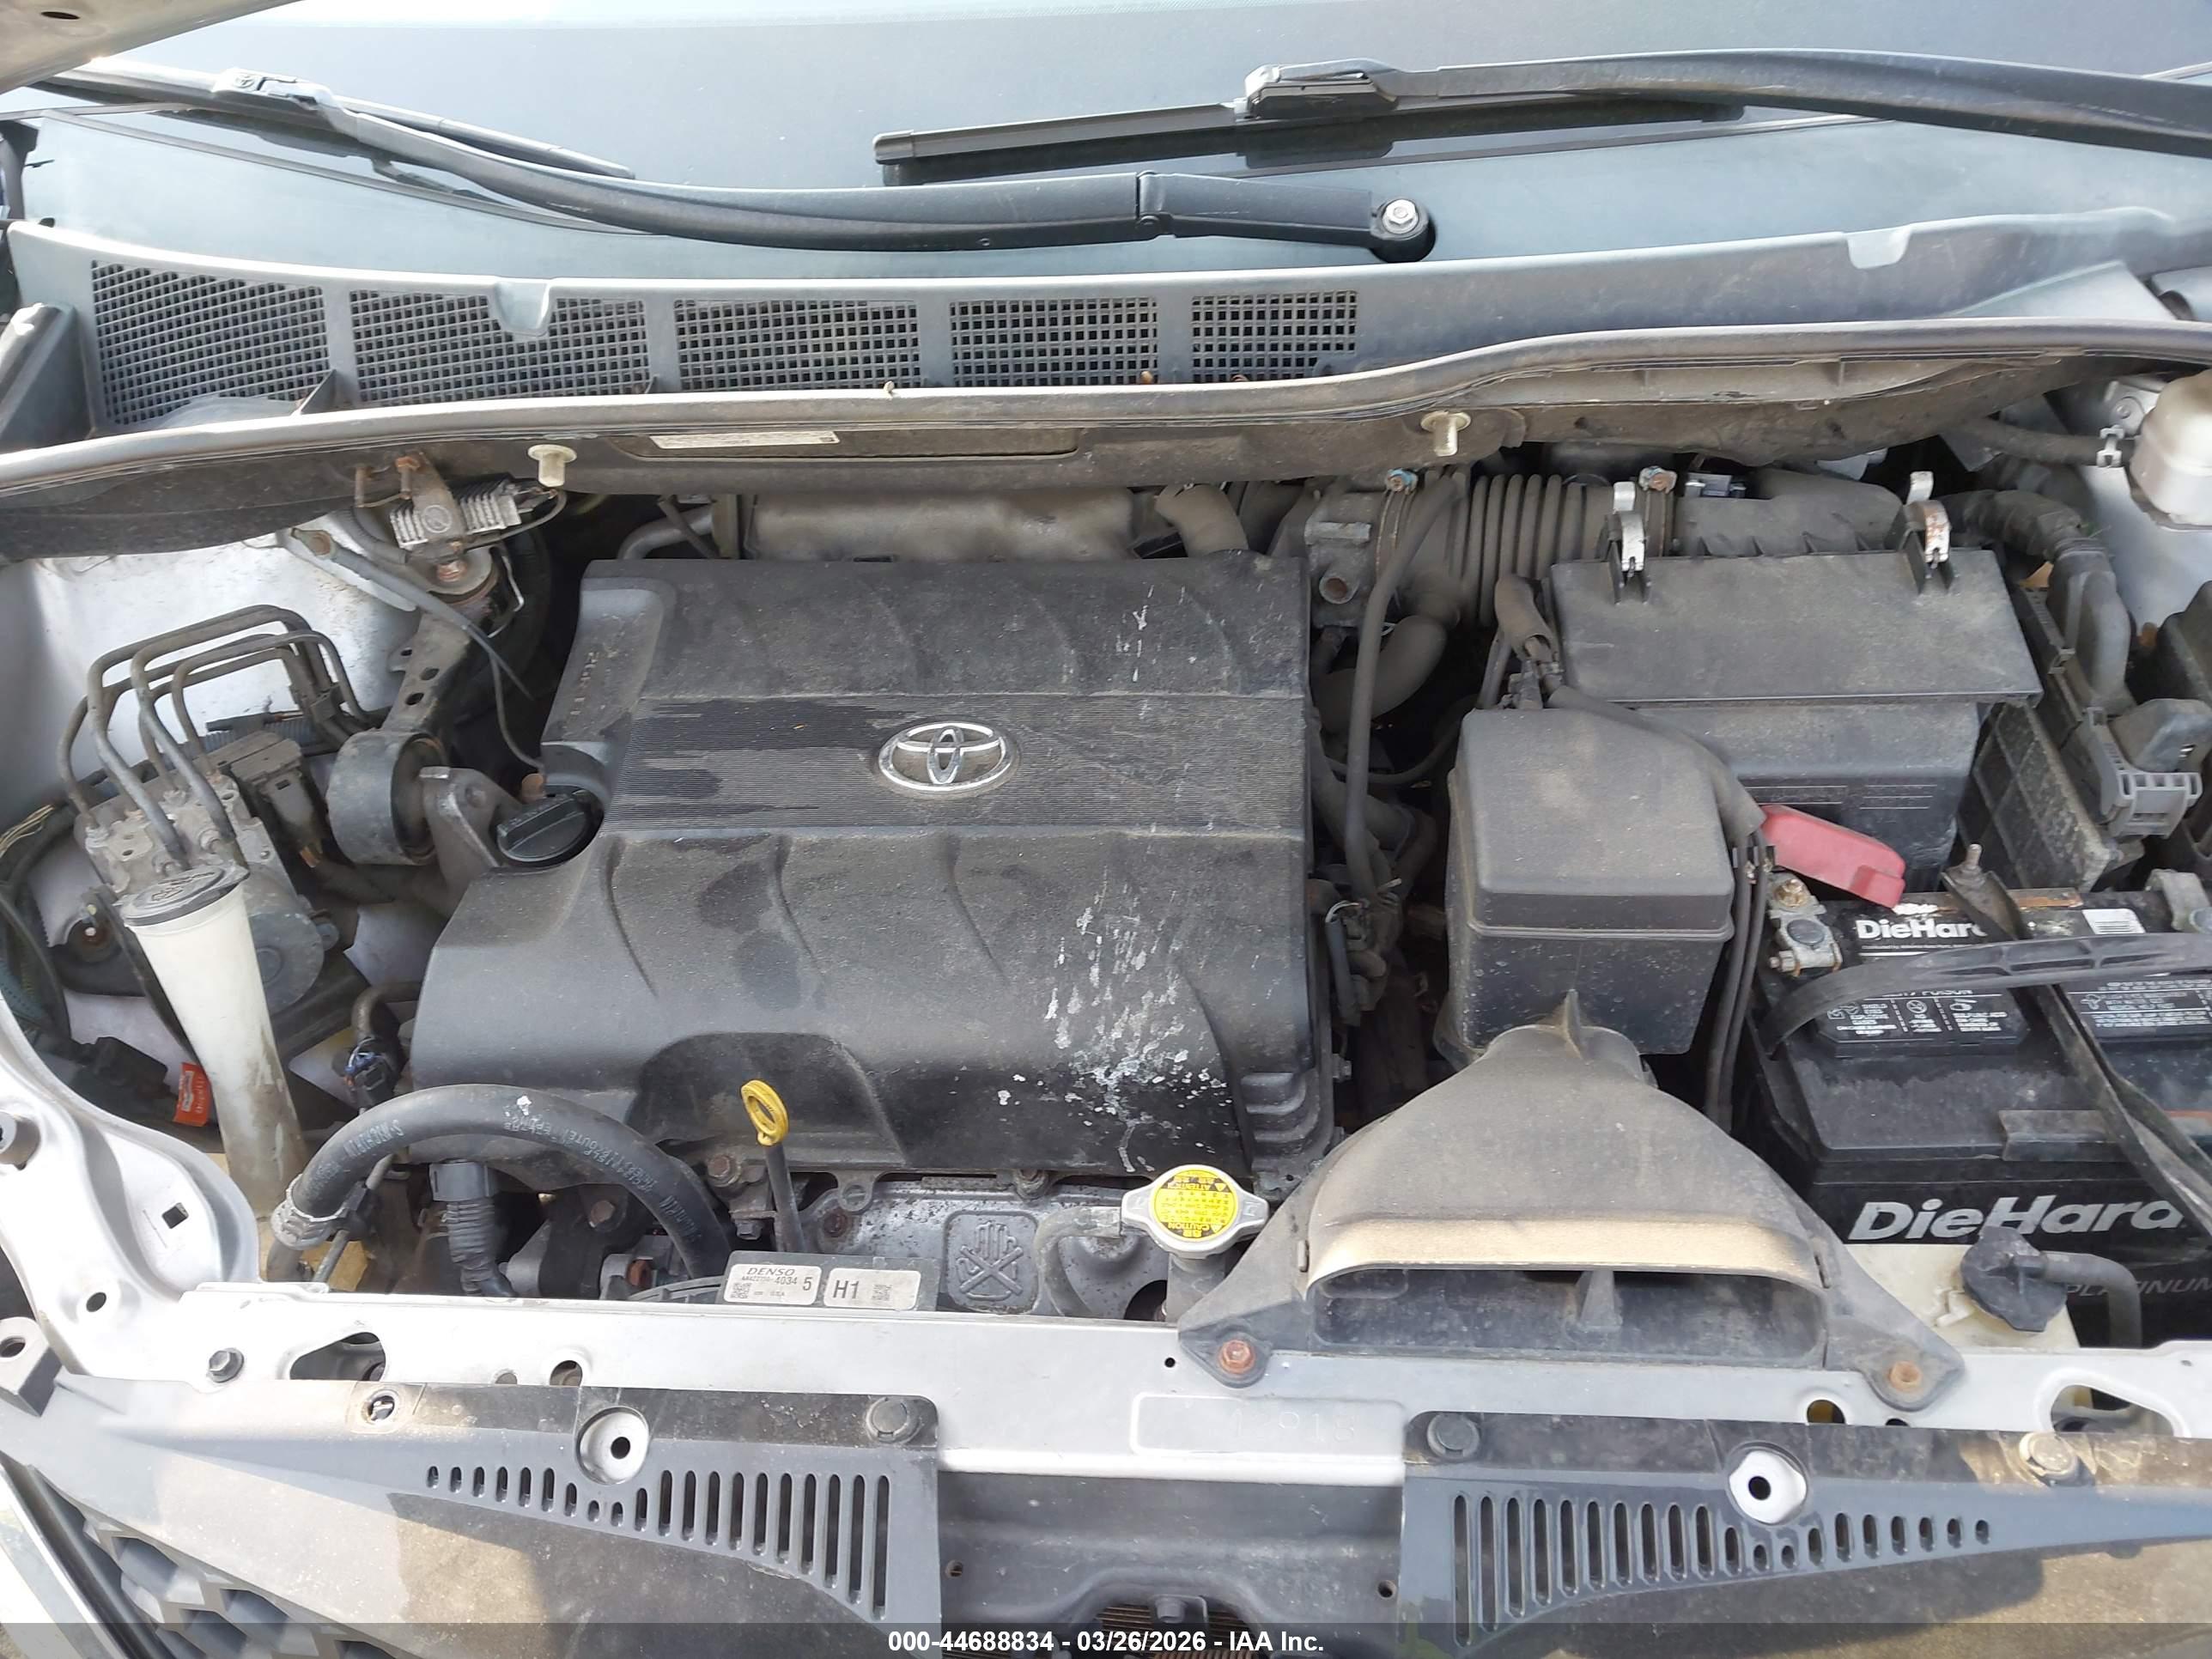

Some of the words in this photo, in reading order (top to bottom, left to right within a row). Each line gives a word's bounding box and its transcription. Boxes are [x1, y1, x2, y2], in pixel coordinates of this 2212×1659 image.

[1168, 1222, 1210, 1231] CAUTION
[747, 1267, 795, 1276] DENSO
[802, 1276, 813, 1291] 5
[833, 1279, 859, 1299] H1
